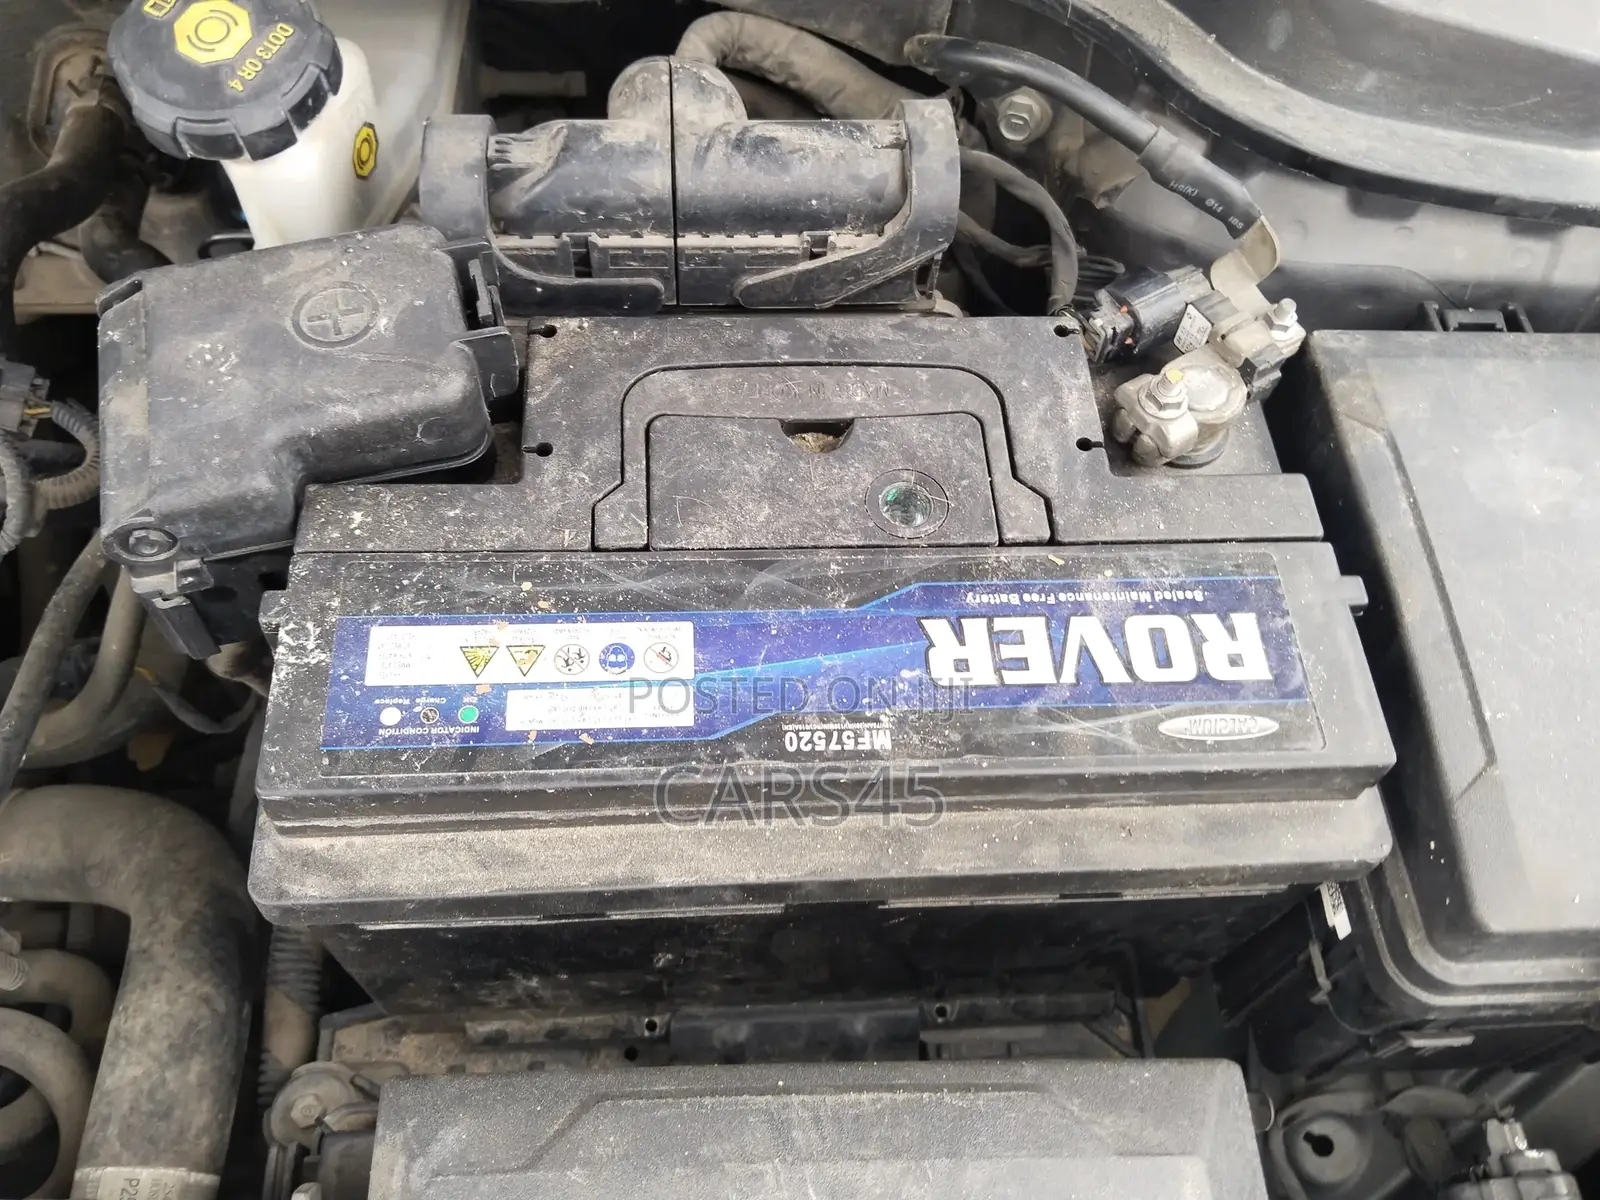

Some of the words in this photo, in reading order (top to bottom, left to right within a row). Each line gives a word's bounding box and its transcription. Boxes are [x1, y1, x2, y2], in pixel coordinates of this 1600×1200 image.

[255, 22, 295, 60] DOT3
[236, 59, 263, 81] OR
[227, 78, 244, 92] 4
[966, 592, 1021, 605] Battery
[1022, 592, 1056, 604] Free
[1058, 591, 1149, 603] Maintenance
[1154, 590, 1204, 602] Sealed
[918, 612, 1273, 688] ROVER
[416, 697, 447, 705] Charge
[379, 727, 429, 736] CONDITION
[430, 726, 480, 735] INDICATOR
[1186, 717, 1259, 736] CALCIUM
[784, 729, 893, 752] MF57520
